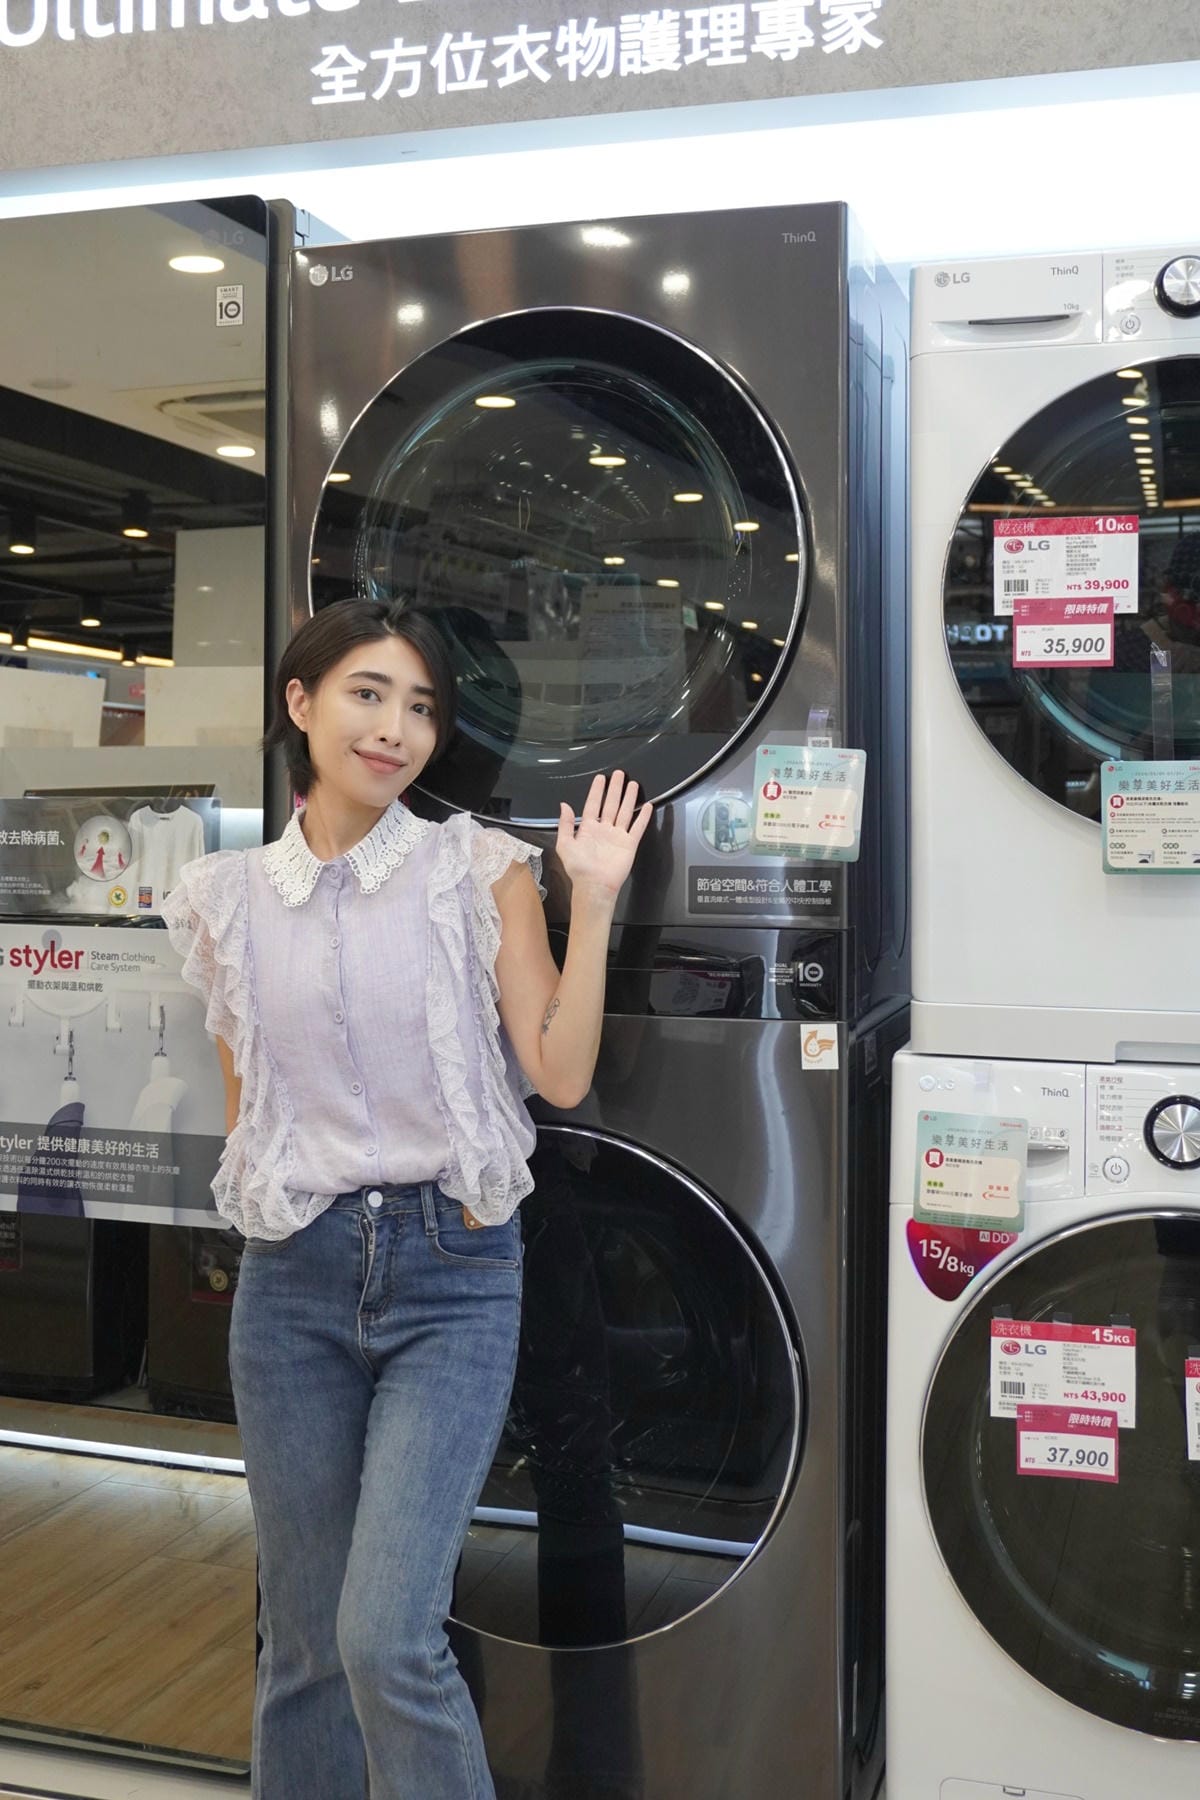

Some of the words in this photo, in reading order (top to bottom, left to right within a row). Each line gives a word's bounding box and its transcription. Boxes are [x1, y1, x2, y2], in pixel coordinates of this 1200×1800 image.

[310, 0, 884, 105] 全方位衣物護理專家
[781, 231, 817, 245] ThinQ
[331, 266, 353, 282] LG
[952, 272, 970, 285] LG
[1051, 266, 1079, 277] ThinQ
[218, 301, 241, 319] 10
[998, 522, 1035, 535] 乾衣機
[1095, 517, 1134, 532] 10KG
[1027, 540, 1051, 551] LG
[1084, 579, 1129, 592] 39,900
[1064, 602, 1109, 615] 限時特價
[1043, 637, 1105, 657] 35,900
[697, 878, 832, 893] 節省空間&符合人體工學
[9, 940, 84, 975] styler
[91, 950, 120, 961] Steam
[121, 952, 156, 964] Clothing
[91, 963, 109, 972] Care
[110, 963, 141, 973] System
[798, 962, 824, 982] 10
[936, 1079, 955, 1090] LG
[1040, 1086, 1070, 1098] ThinQ
[37, 1136, 159, 1159] 提供健康美好的生活
[979, 1231, 990, 1243] AI
[992, 1232, 1010, 1244] DD
[994, 1323, 1032, 1337] 洗衣機
[1091, 1328, 1130, 1344] 15KG
[1024, 1343, 1047, 1355] LG
[1080, 1390, 1126, 1403] 43,900
[1067, 1412, 1113, 1428] 限時特價
[1047, 1447, 1109, 1467] 37,900
